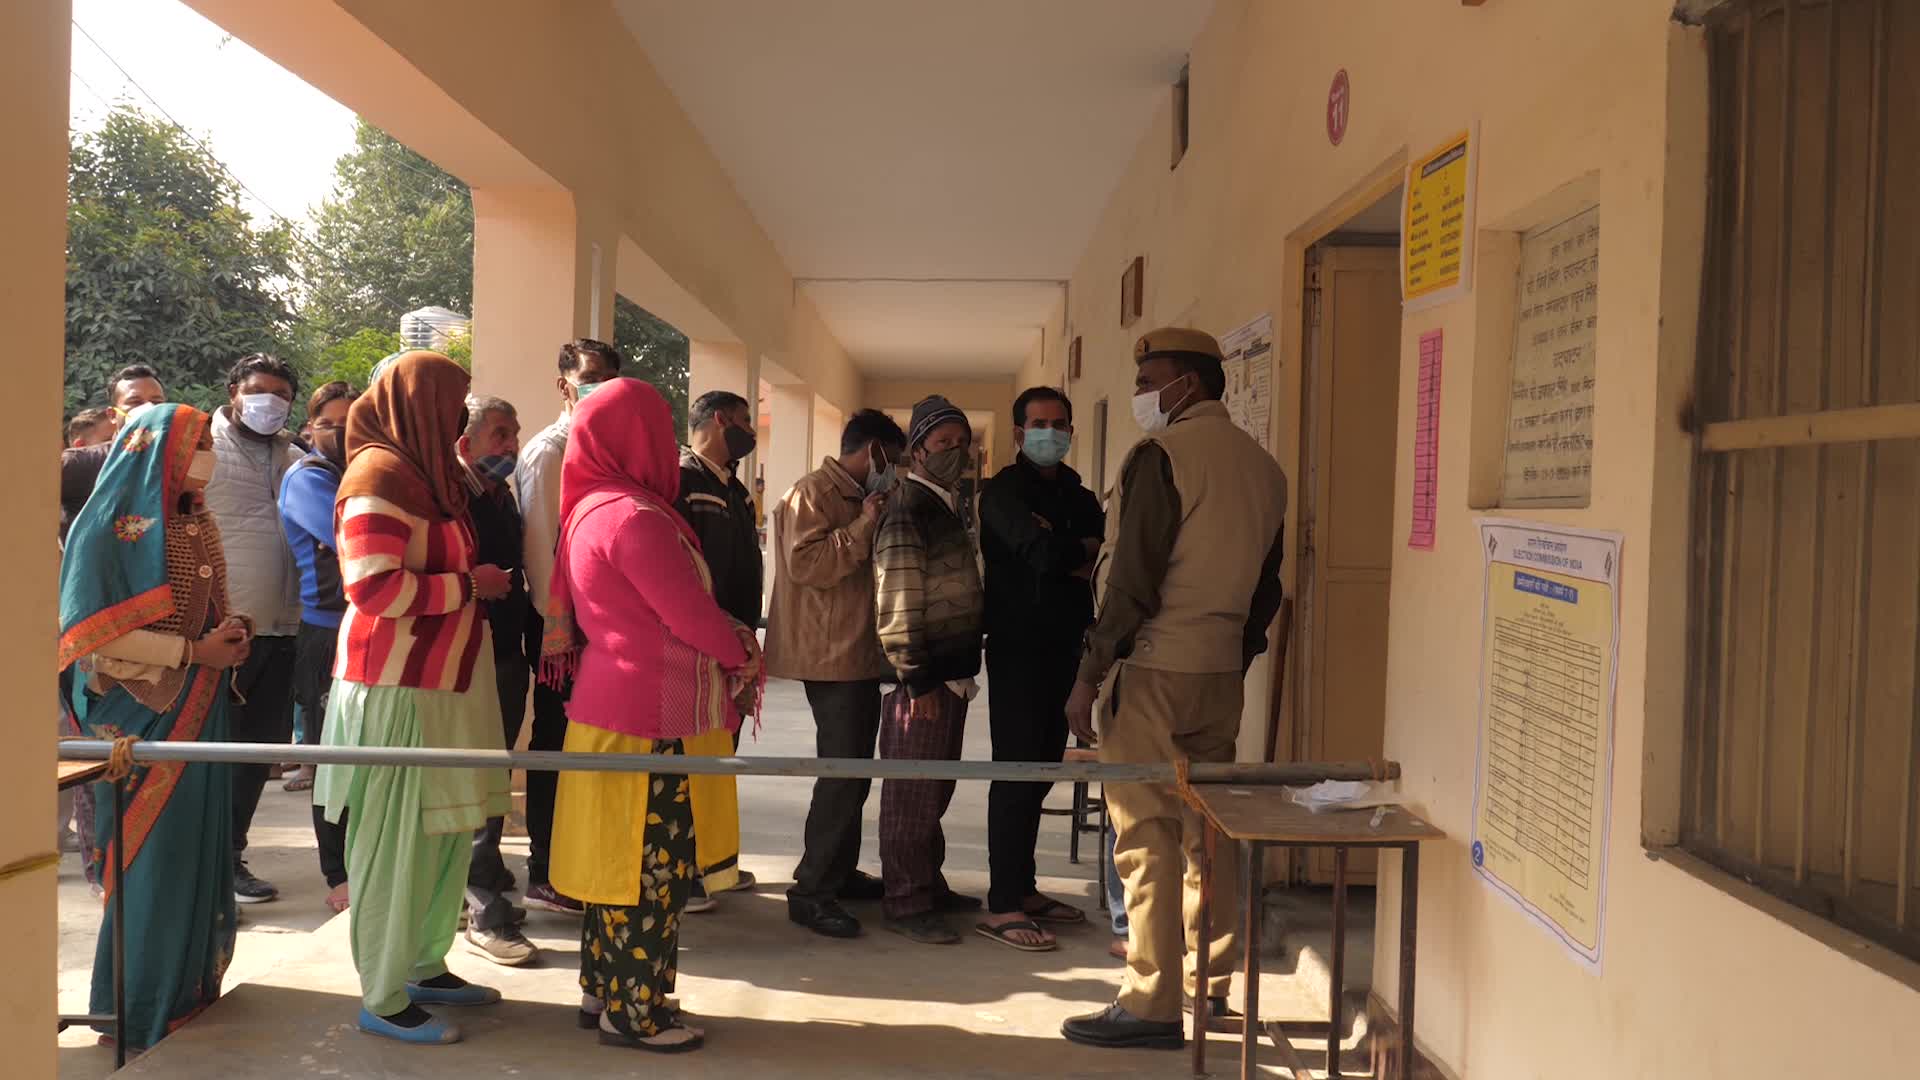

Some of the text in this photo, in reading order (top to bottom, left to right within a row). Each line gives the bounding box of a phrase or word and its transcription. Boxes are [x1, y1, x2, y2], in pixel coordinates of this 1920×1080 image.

[1513, 549, 1533, 560] ELECTION
[1534, 553, 1561, 566] COMMISSION
[1569, 559, 1582, 570] INDIA
